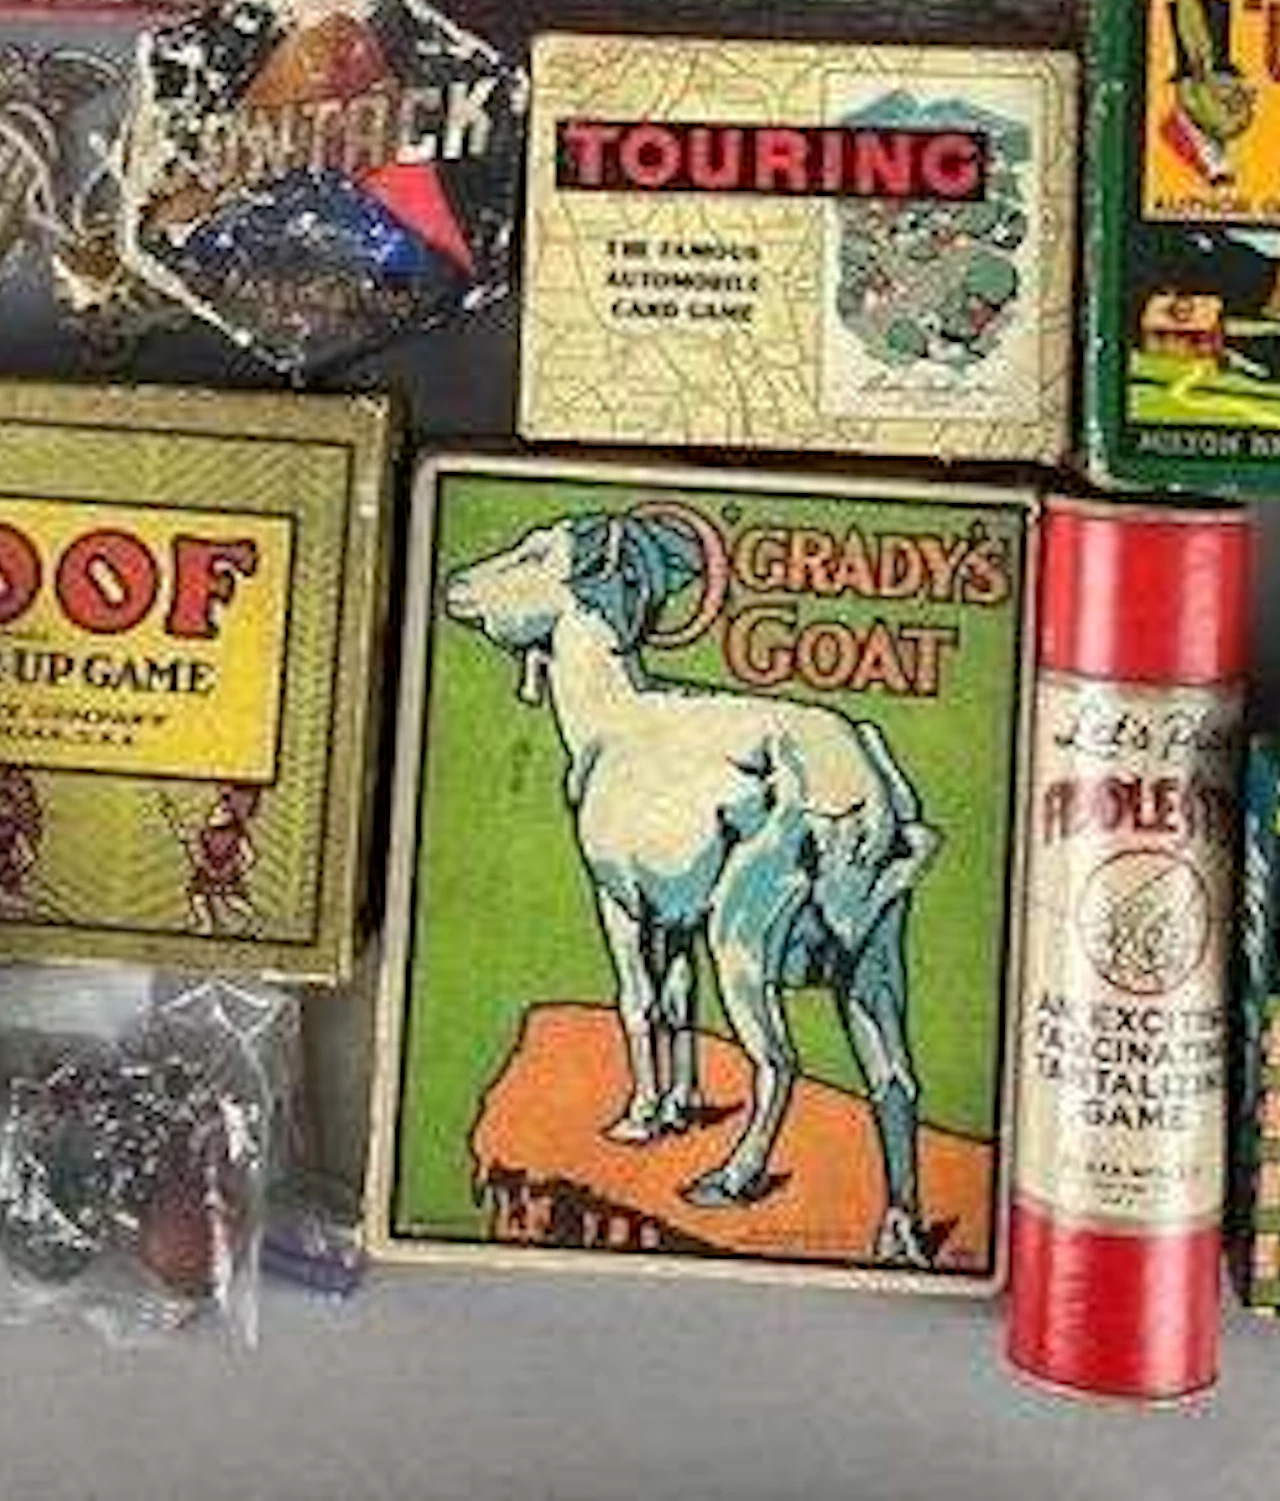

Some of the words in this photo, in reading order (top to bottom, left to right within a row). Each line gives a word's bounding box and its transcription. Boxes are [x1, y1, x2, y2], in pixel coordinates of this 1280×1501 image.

[562, 122, 984, 197] TOURING
[606, 240, 654, 260] THE
[658, 240, 761, 263] FAMOUS
[606, 270, 760, 295] AUTOMOBILE
[611, 301, 682, 322] CARD
[685, 301, 756, 324] GAME
[724, 604, 962, 697] GOAT
[18, 650, 74, 686] UP
[82, 654, 218, 693] GAME
[1083, 1098, 1188, 1133] GAME
